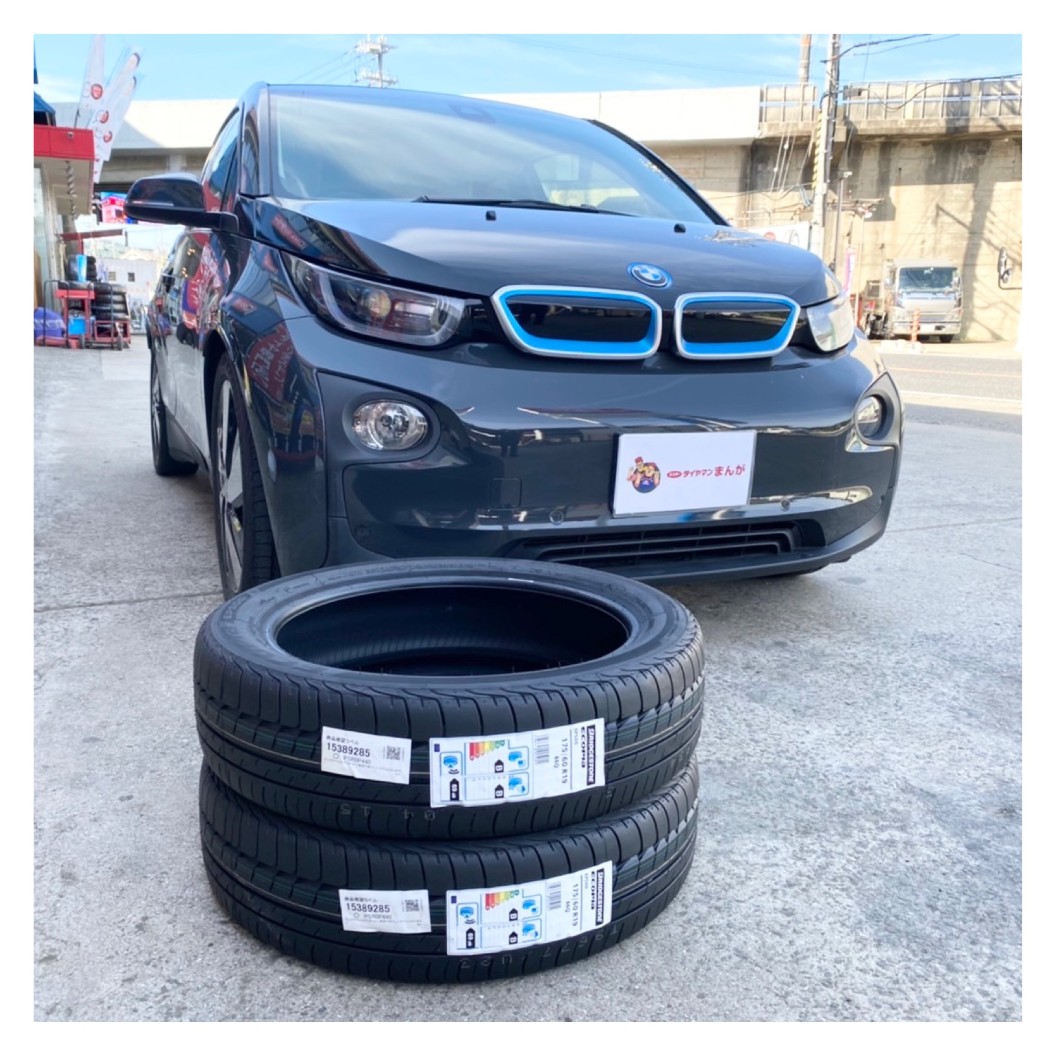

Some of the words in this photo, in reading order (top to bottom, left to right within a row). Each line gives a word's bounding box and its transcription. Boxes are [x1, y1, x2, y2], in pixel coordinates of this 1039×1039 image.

[714, 463, 746, 477] まんが
[327, 743, 371, 757] 15389285
[346, 903, 390, 913] 15389285
